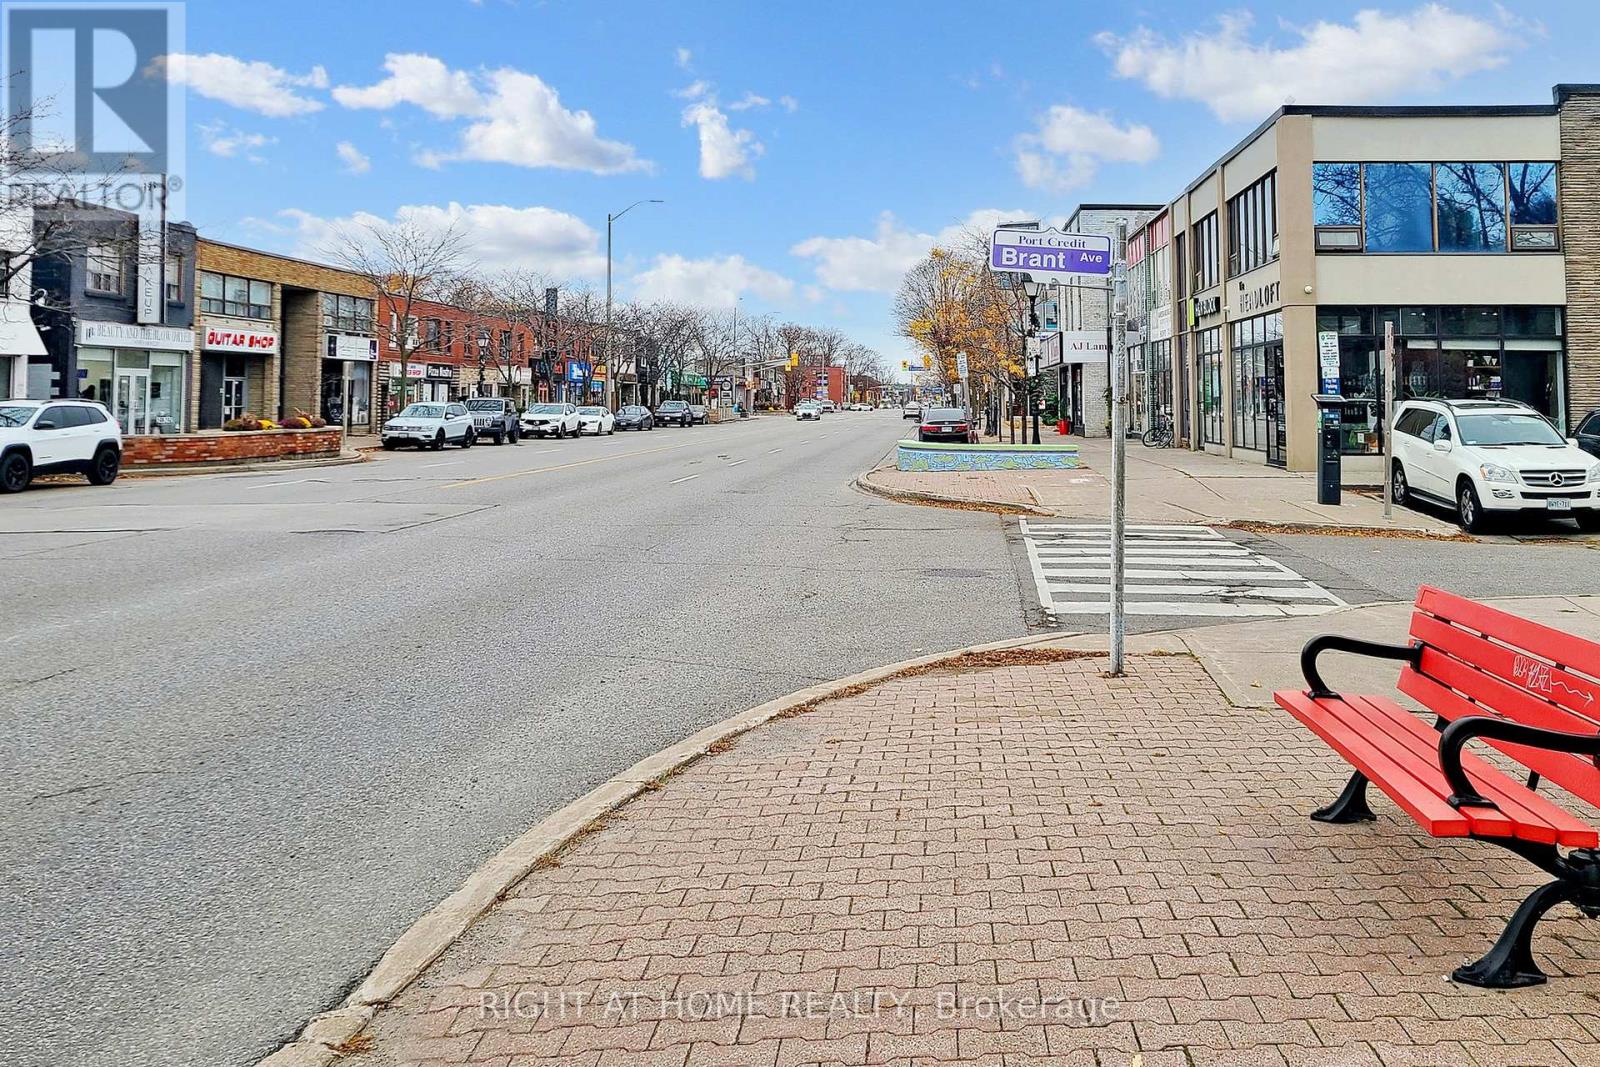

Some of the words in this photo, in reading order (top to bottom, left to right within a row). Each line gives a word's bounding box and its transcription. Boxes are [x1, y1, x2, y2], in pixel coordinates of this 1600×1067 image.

[1019, 235, 1043, 246] Port
[1048, 237, 1087, 249] Credit
[1001, 247, 1066, 268] Brant
[1079, 252, 1103, 264] Ave
[208, 332, 246, 346] GUITAR
[248, 335, 275, 349] SHOP
[1070, 342, 1083, 351] AJ
